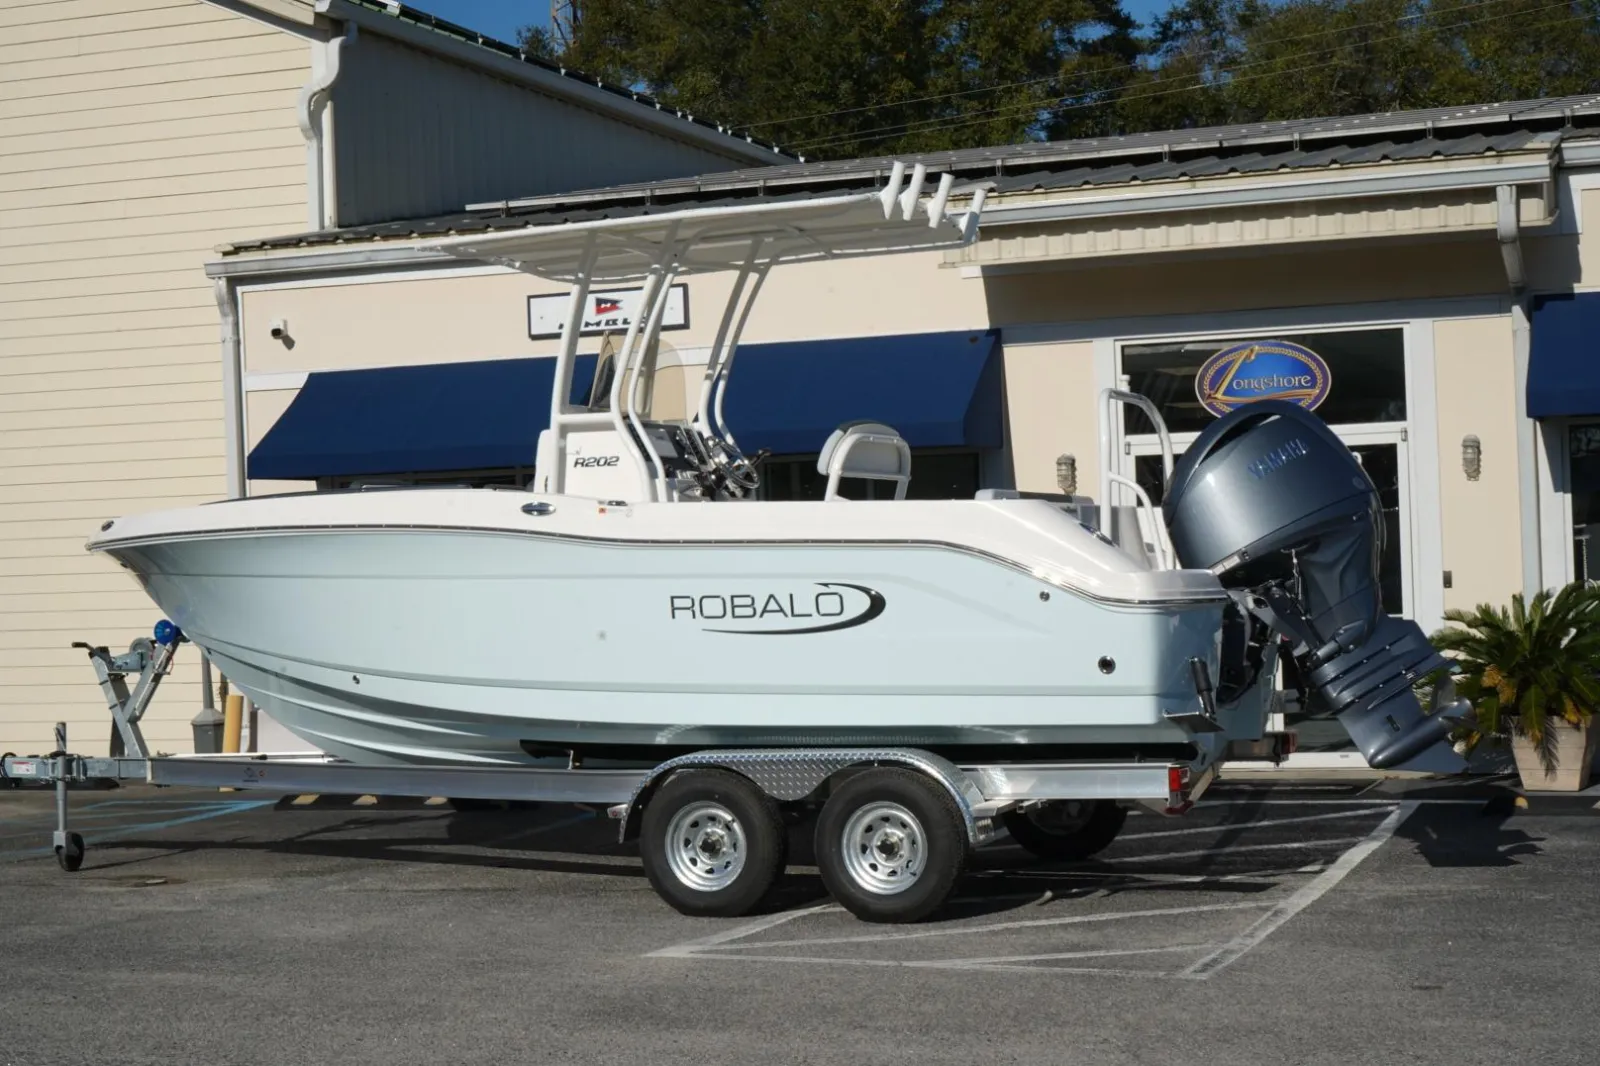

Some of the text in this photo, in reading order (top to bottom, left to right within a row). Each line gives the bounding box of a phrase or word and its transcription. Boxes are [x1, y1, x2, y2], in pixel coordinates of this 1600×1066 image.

[1204, 345, 1320, 404] Longshore
[573, 456, 620, 468] R202
[670, 592, 845, 620] ROBALO
